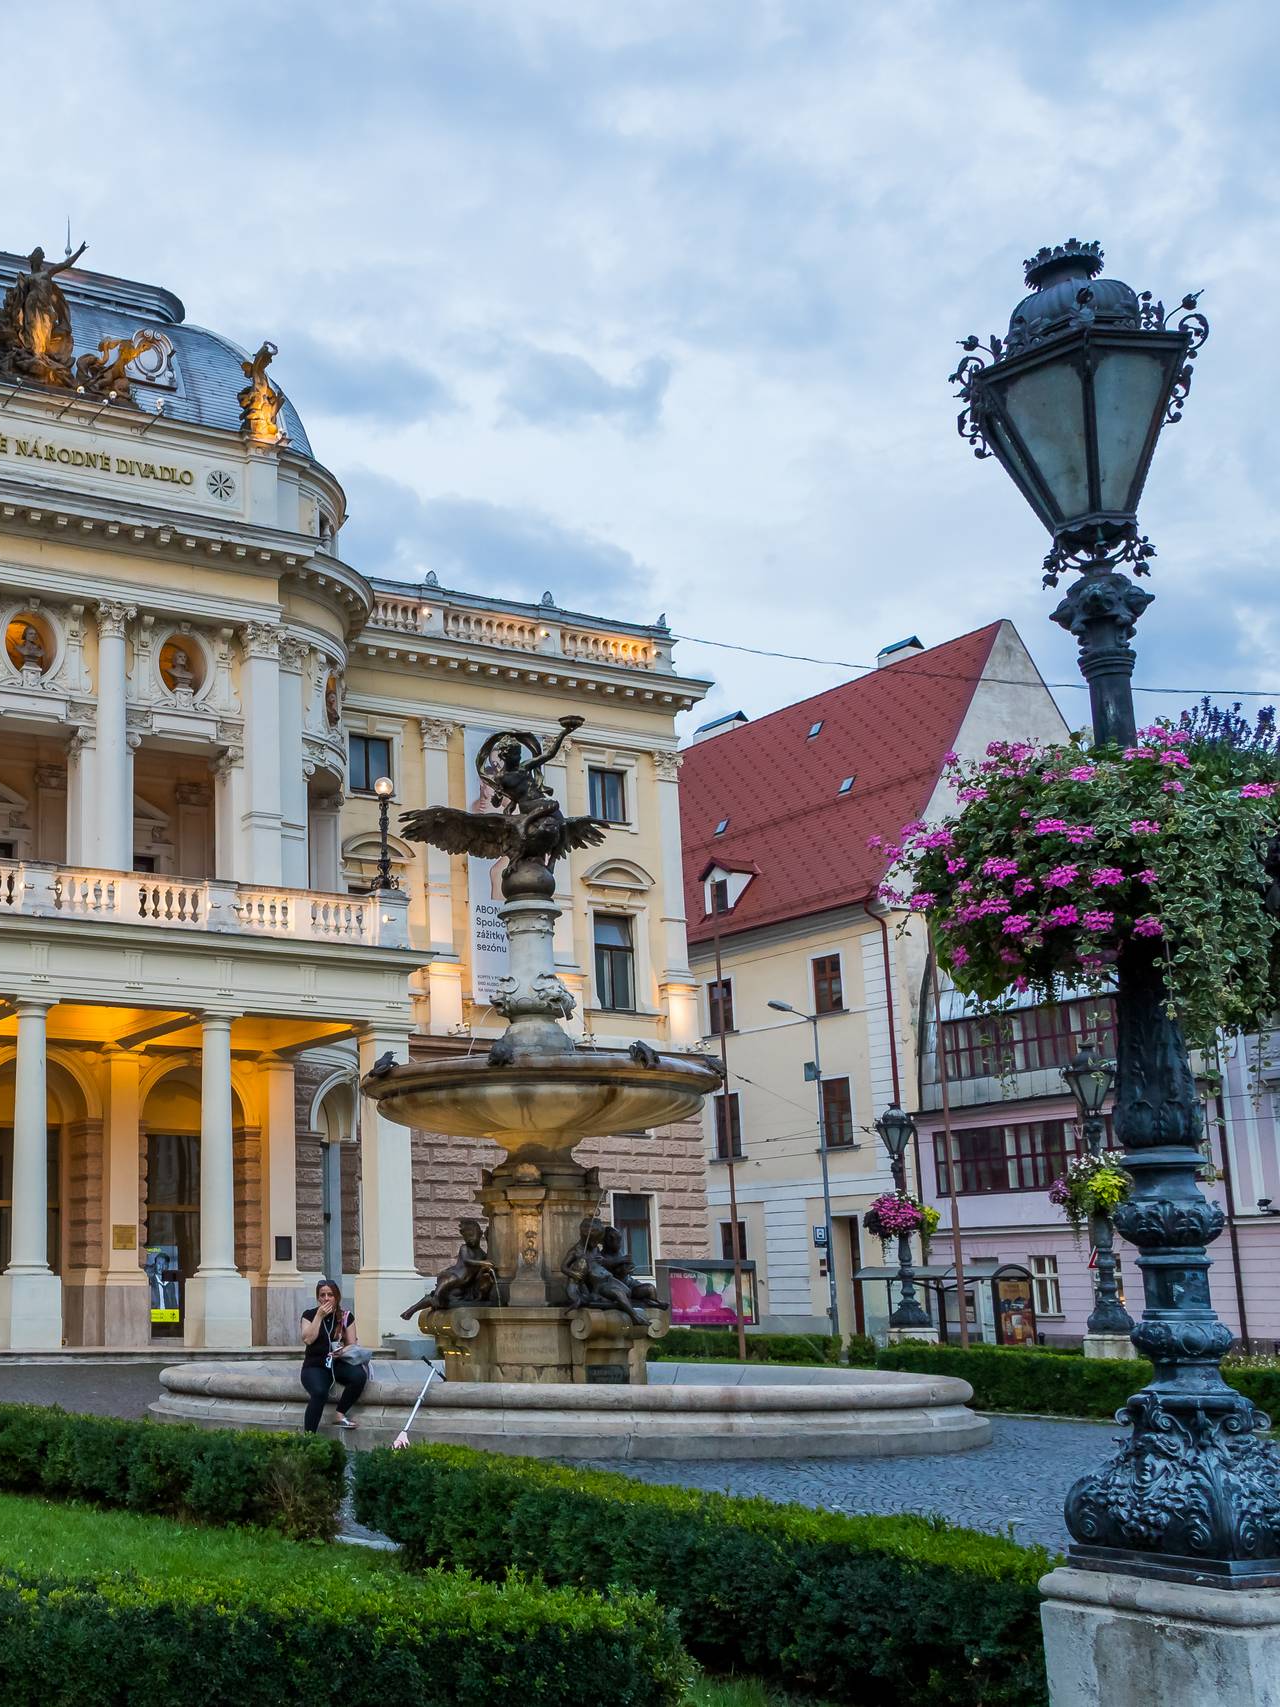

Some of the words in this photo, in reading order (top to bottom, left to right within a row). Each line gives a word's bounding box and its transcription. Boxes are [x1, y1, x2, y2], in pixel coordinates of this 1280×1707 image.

[15, 440, 111, 472] NÁRODNÉ
[116, 458, 194, 485] DIVADLO
[476, 930, 506, 943] zážitky
[476, 943, 507, 953] sezónu
